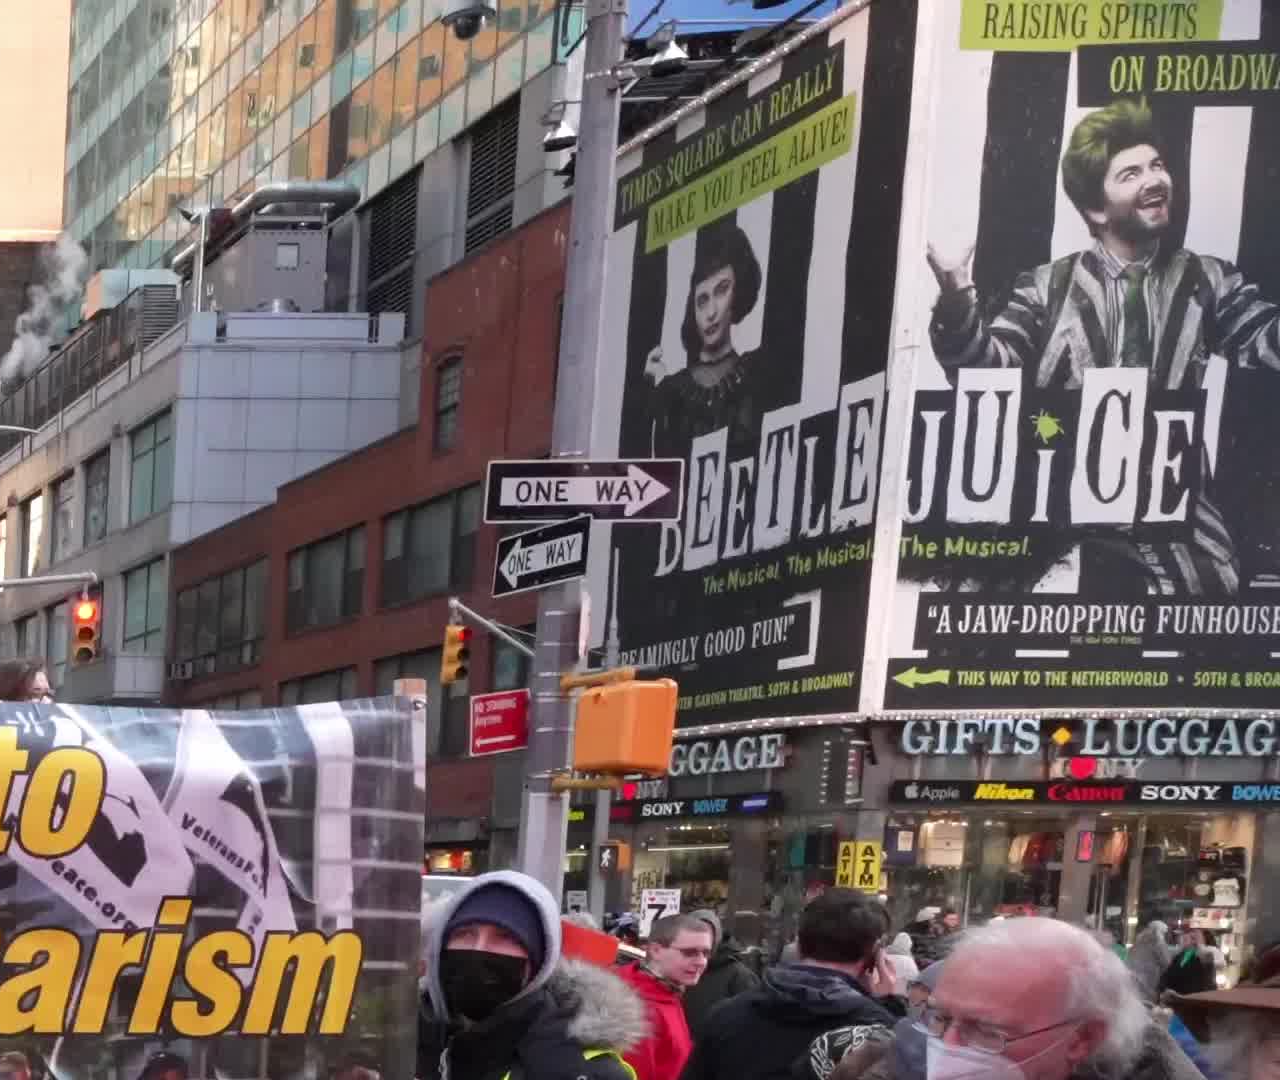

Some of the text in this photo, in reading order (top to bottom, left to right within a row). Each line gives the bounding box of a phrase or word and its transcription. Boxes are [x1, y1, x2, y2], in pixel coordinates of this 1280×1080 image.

[983, 3, 1198, 39] RAISING SPIRITS
[1109, 56, 1145, 93] ON
[621, 53, 838, 214] TIMES SQUARE CAN REALLY
[653, 107, 849, 235] MAKE YOU FEEL ALIVE!
[516, 480, 652, 504] ONE WAY
[507, 539, 577, 577] ONE WAY
[900, 535, 1033, 557] The Musical.
[703, 577, 725, 596] The
[790, 555, 812, 577] The
[958, 604, 1146, 634] JAW-DROPPING
[704, 626, 745, 659] GOOD
[801, 672, 855, 693] BROADWAY
[957, 669, 986, 687] THIS
[989, 669, 1019, 686] WAY
[1023, 669, 1041, 686] TO
[1045, 670, 1068, 686] THE
[1071, 670, 1169, 687] NETHERWORLD
[1193, 671, 1227, 687] 50TH
[1231, 672, 1241, 687] &
[901, 719, 1280, 756] GIFTS LUGGAG
[974, 783, 1036, 801] Nikon
[1047, 784, 1125, 801] Canon
[1141, 785, 1221, 800] SONY
[641, 802, 684, 817] SONY
[859, 845, 875, 886] ATM
